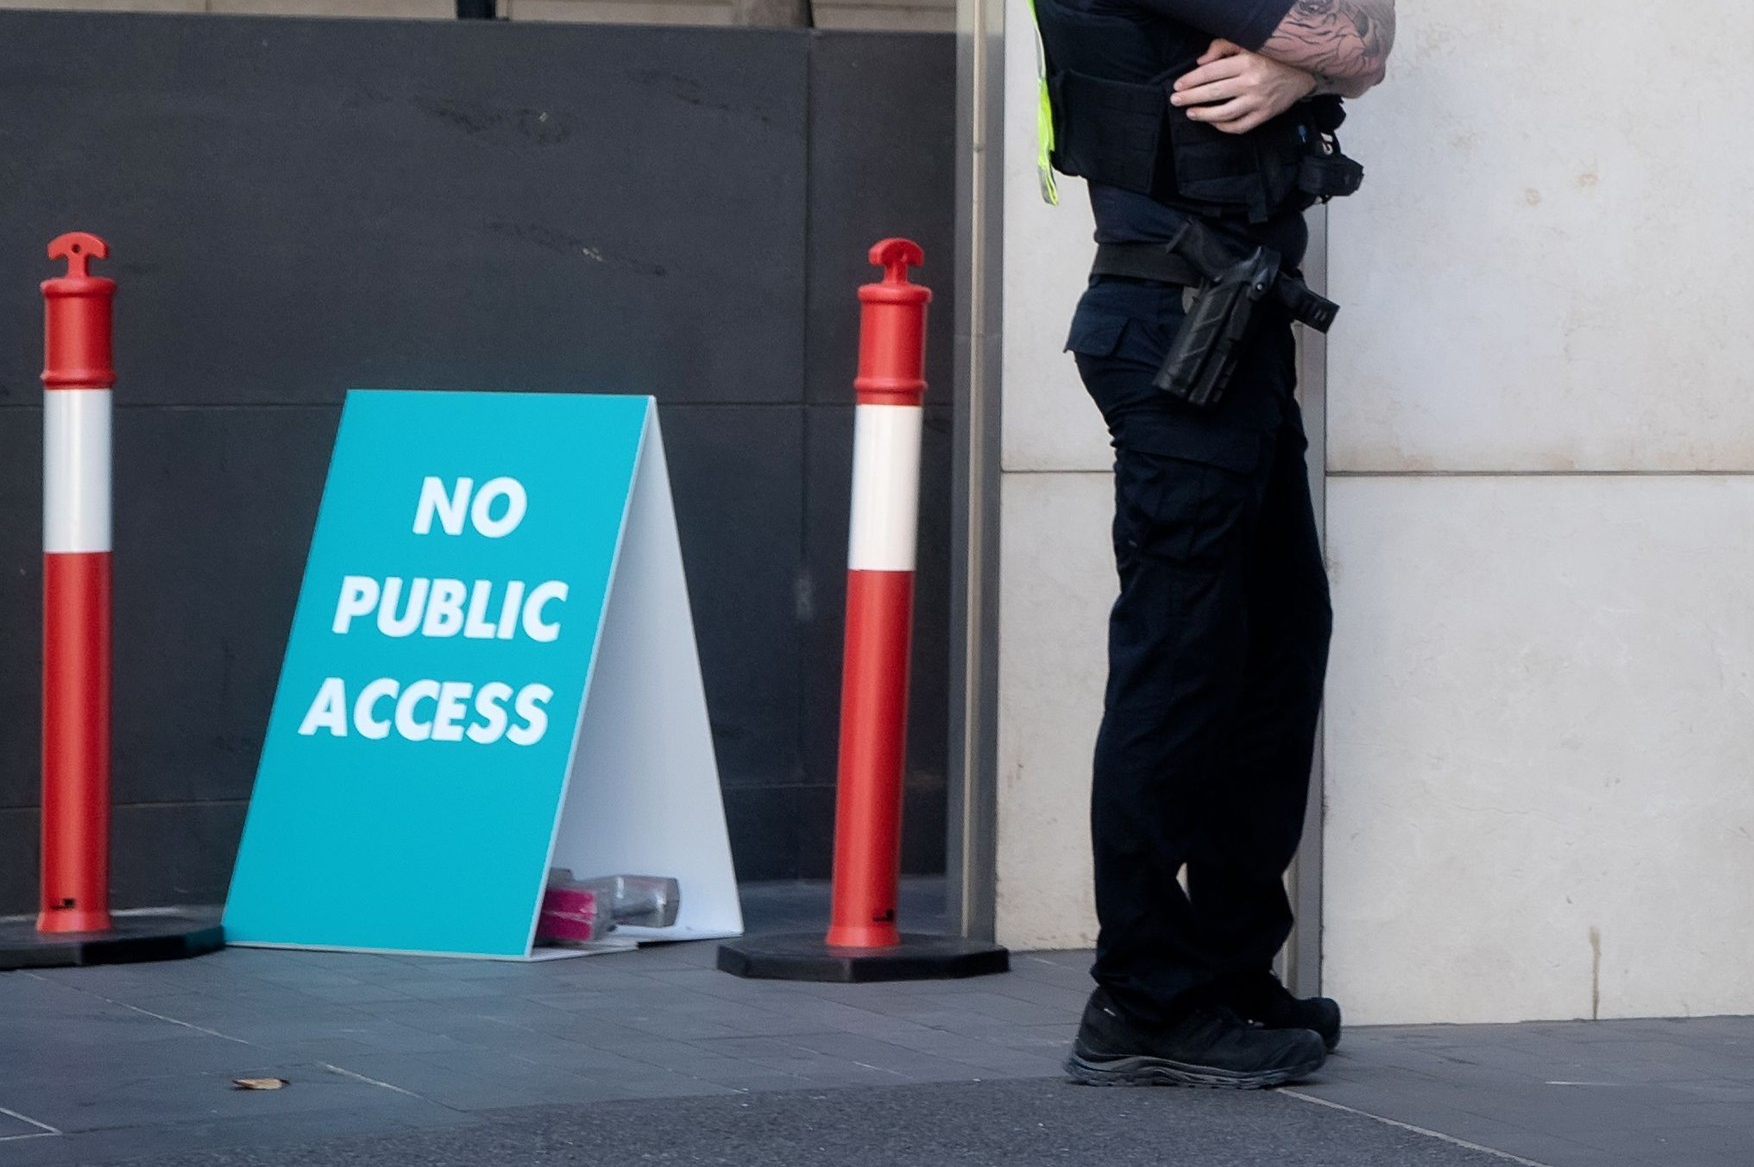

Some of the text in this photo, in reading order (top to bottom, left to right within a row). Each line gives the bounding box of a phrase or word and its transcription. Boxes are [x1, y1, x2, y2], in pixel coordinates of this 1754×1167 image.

[412, 476, 528, 539] NO
[332, 575, 569, 643] PUBLIC
[298, 677, 554, 746] ACCESS
